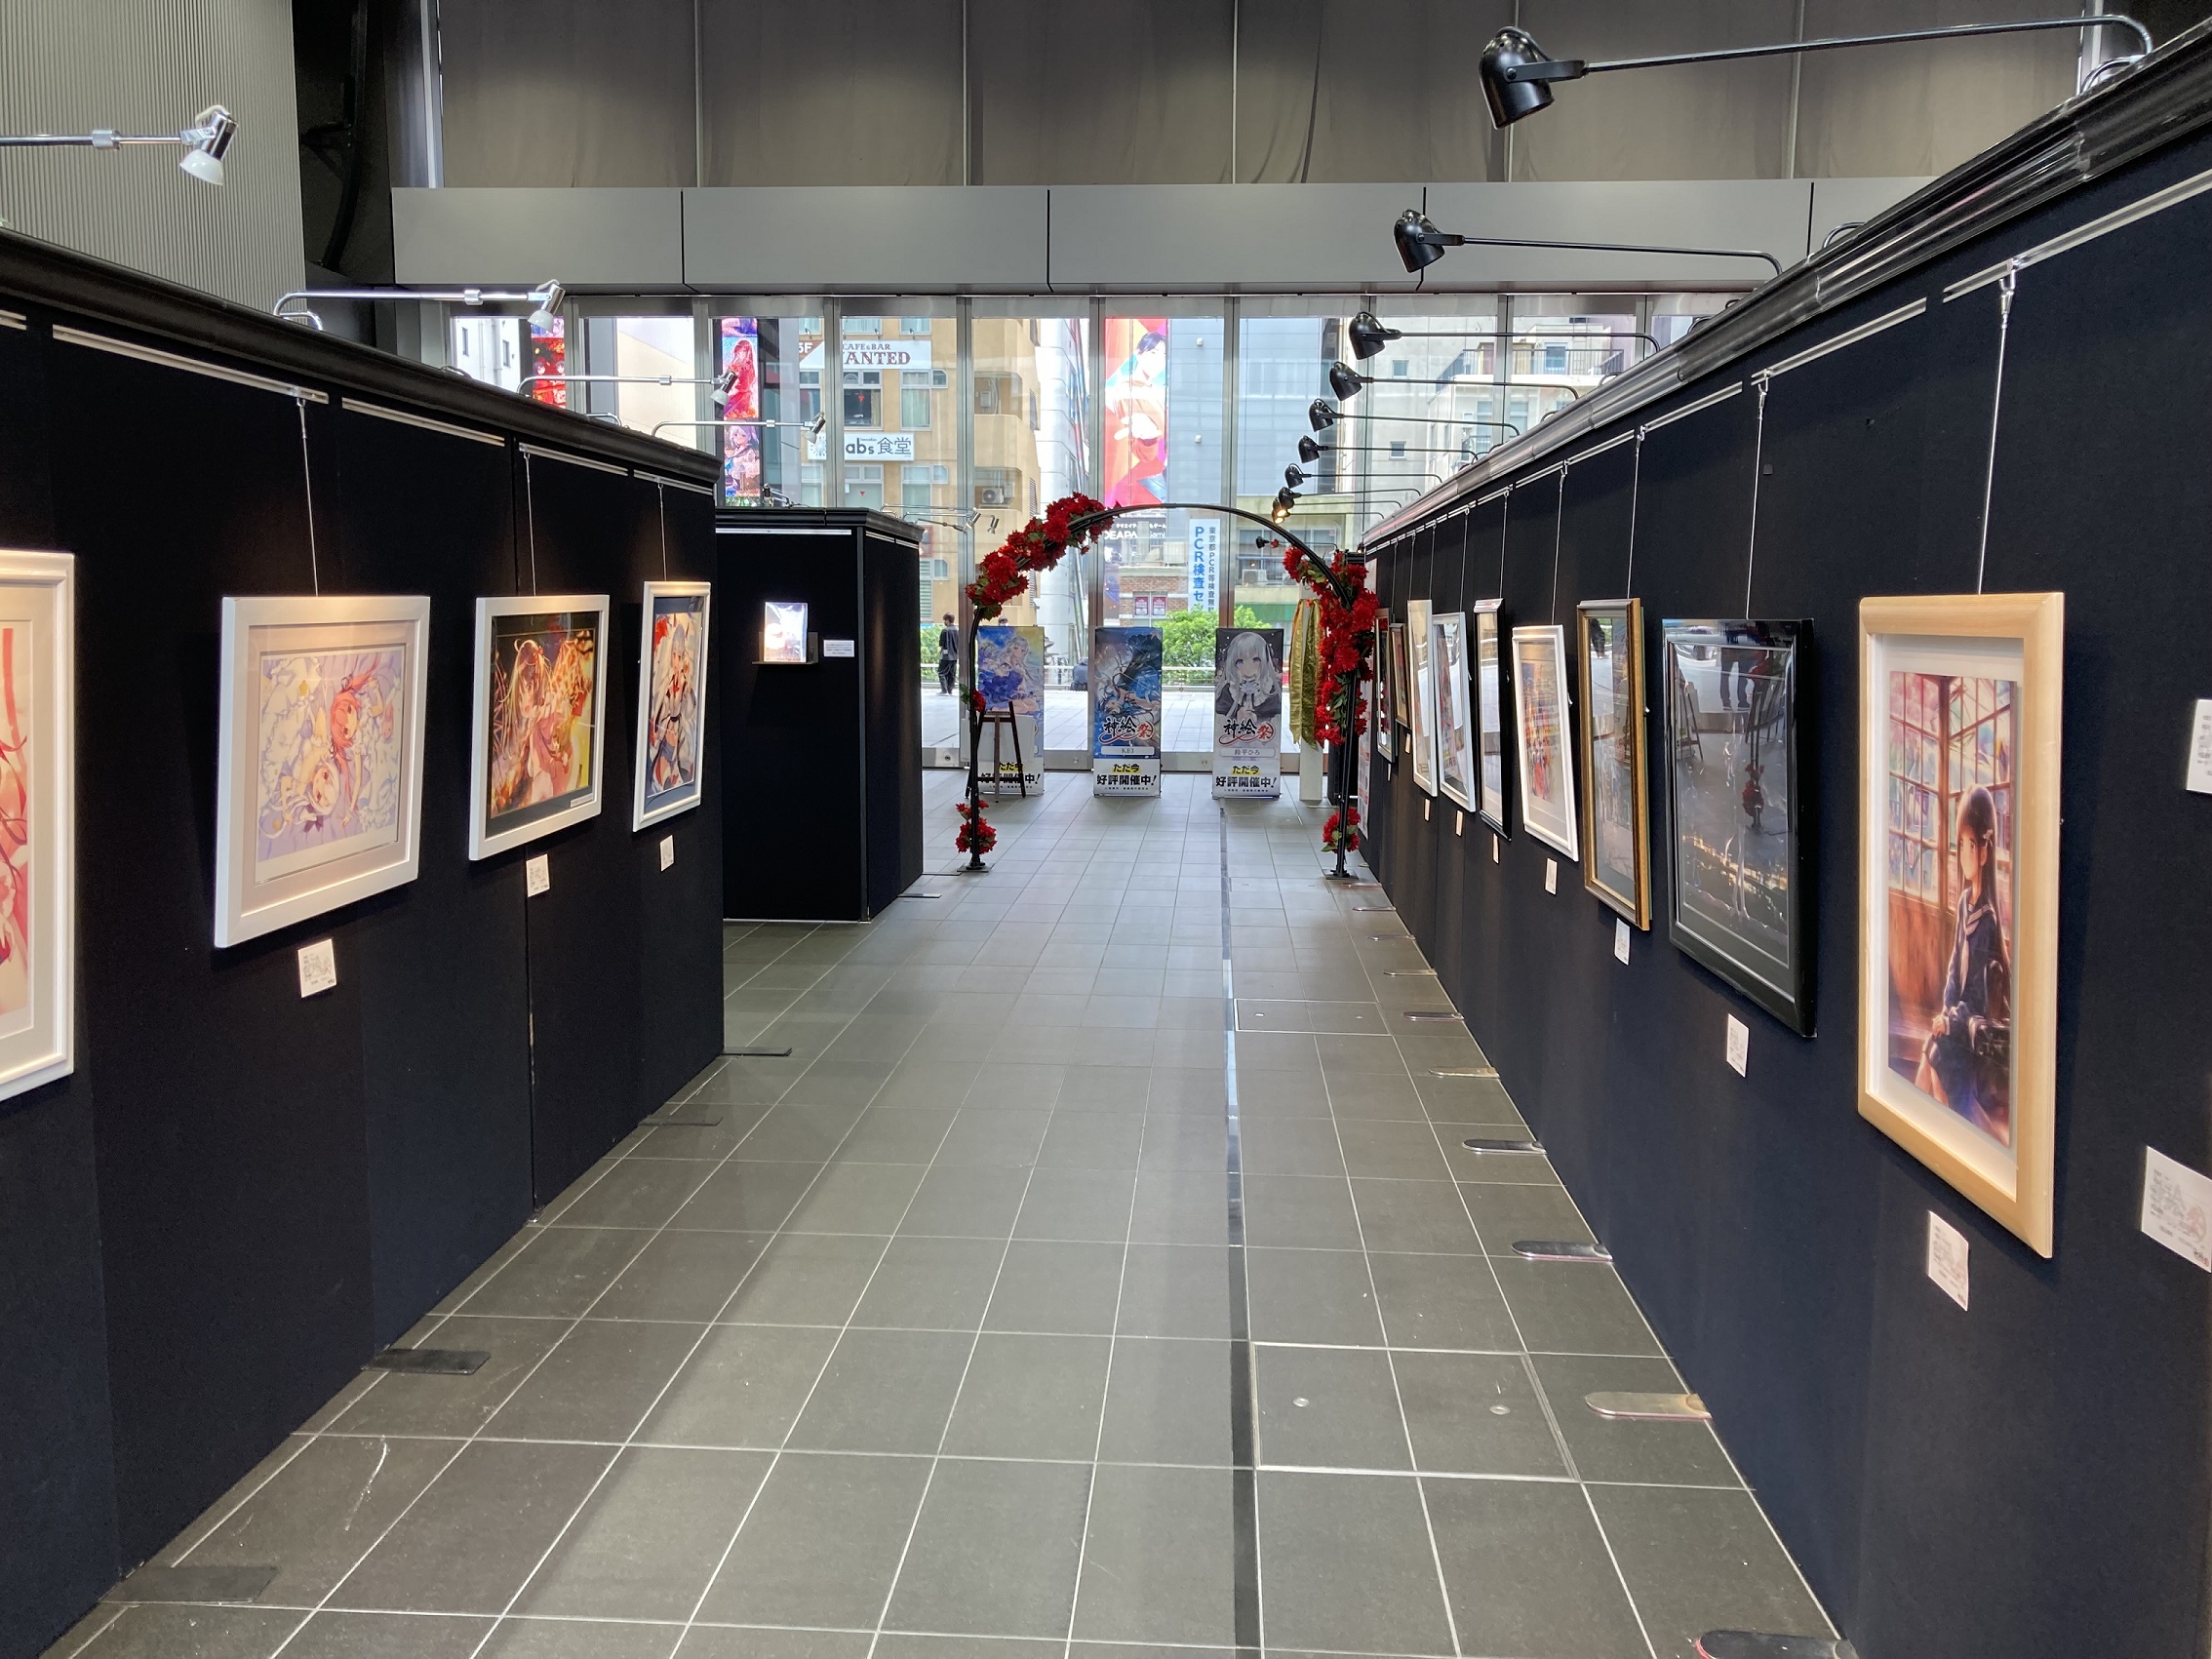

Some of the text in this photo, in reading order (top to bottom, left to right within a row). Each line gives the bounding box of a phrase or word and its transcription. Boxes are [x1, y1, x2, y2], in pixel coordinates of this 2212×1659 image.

[843, 351, 911, 366] ANTED
[1113, 764, 1140, 772] ただ今
[1232, 766, 1260, 775] ただ今
